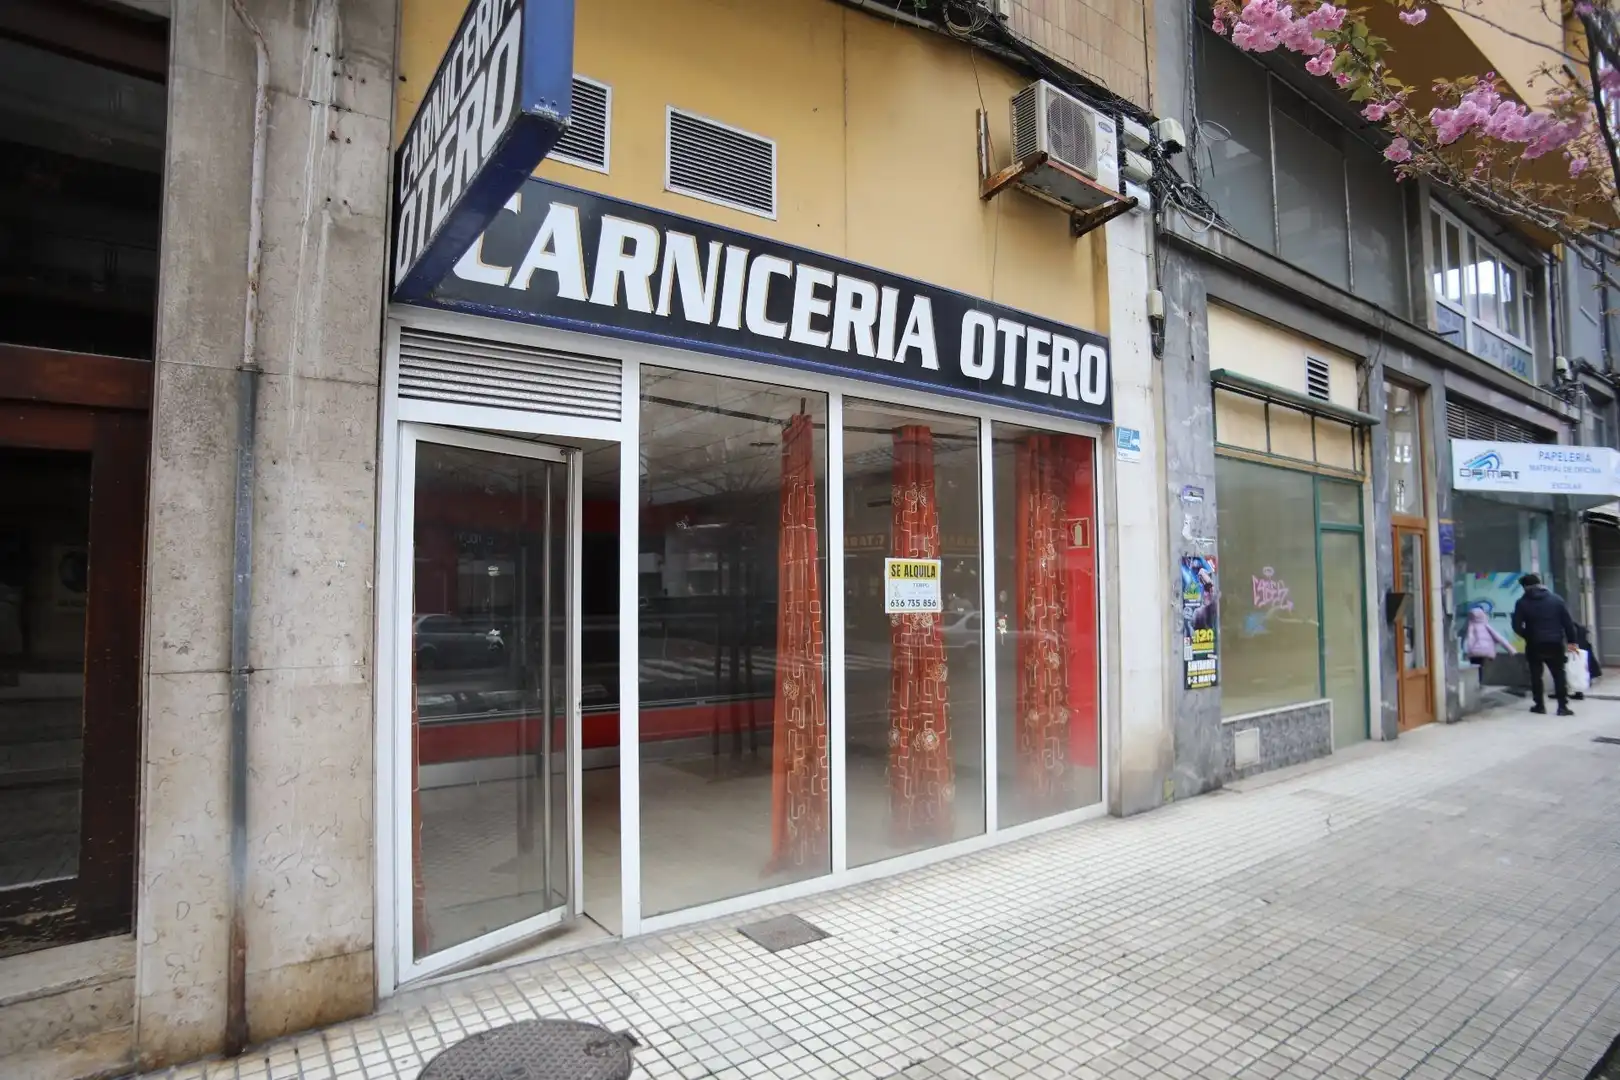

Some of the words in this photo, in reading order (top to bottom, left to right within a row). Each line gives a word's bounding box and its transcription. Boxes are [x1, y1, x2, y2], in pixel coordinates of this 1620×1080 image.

[394, 8, 522, 287] OTERO
[400, 0, 516, 204] CARNICERI
[960, 308, 1108, 405] OTERO
[890, 599, 905, 607] 636
[907, 599, 921, 607] 735
[923, 599, 937, 607] 856
[891, 564, 901, 577] SE
[904, 564, 936, 578] ALQUILA
